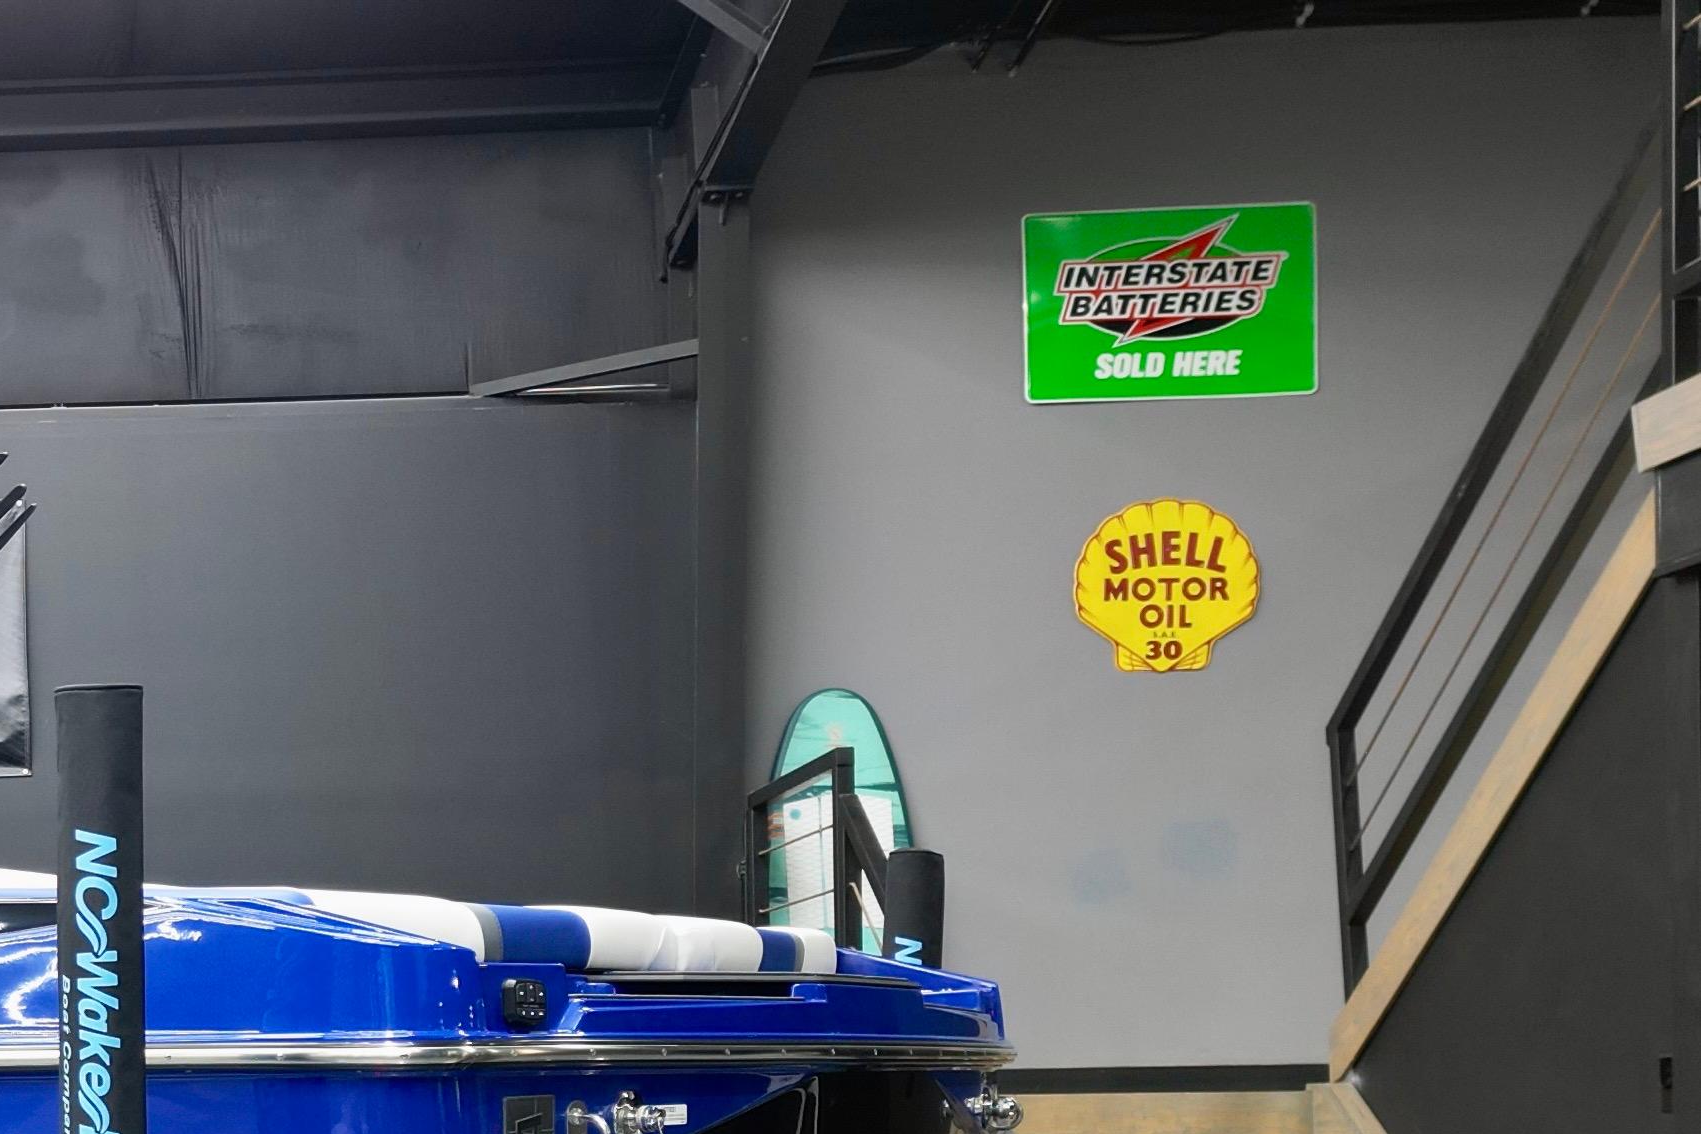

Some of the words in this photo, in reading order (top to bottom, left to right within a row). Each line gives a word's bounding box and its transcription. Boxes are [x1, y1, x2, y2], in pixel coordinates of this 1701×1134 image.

[1063, 259, 1273, 289] INTERSTATE
[1070, 289, 1258, 318] BATTERIES
[1094, 352, 1165, 379] SOLD
[1172, 349, 1243, 377] HERE
[1104, 530, 1227, 575] SHELL
[1103, 577, 1230, 602] MOTOR
[1139, 603, 1193, 629] OIL
[1144, 639, 1184, 661] 30
